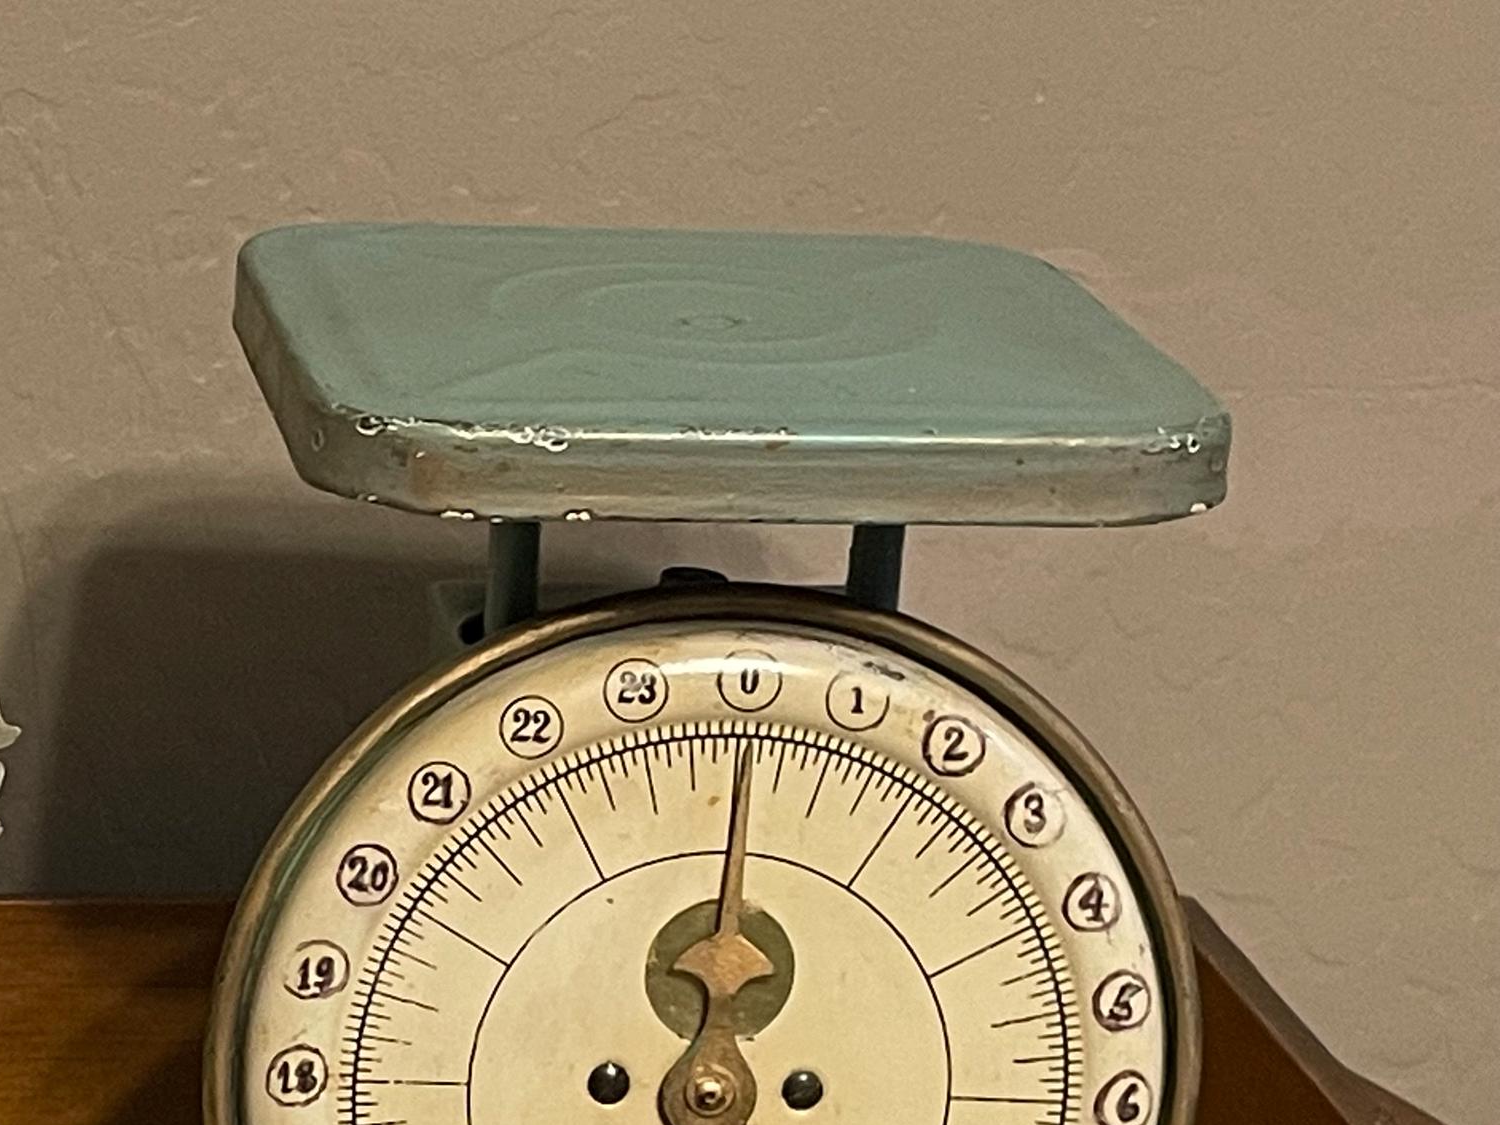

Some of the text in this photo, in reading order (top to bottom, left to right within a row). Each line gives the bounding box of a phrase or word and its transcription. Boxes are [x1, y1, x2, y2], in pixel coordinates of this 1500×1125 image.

[618, 671, 656, 704] 23
[741, 665, 760, 694] 0
[851, 686, 864, 714] 1
[511, 709, 550, 743] 22
[942, 726, 968, 760] 2
[420, 771, 453, 808] 21
[1024, 793, 1047, 833] 3
[347, 855, 387, 892] 20
[1078, 881, 1109, 922] 4
[298, 956, 335, 990] 19
[1108, 982, 1143, 1020] 5
[277, 1059, 317, 1093] 18
[1116, 1083, 1140, 1123] 6
